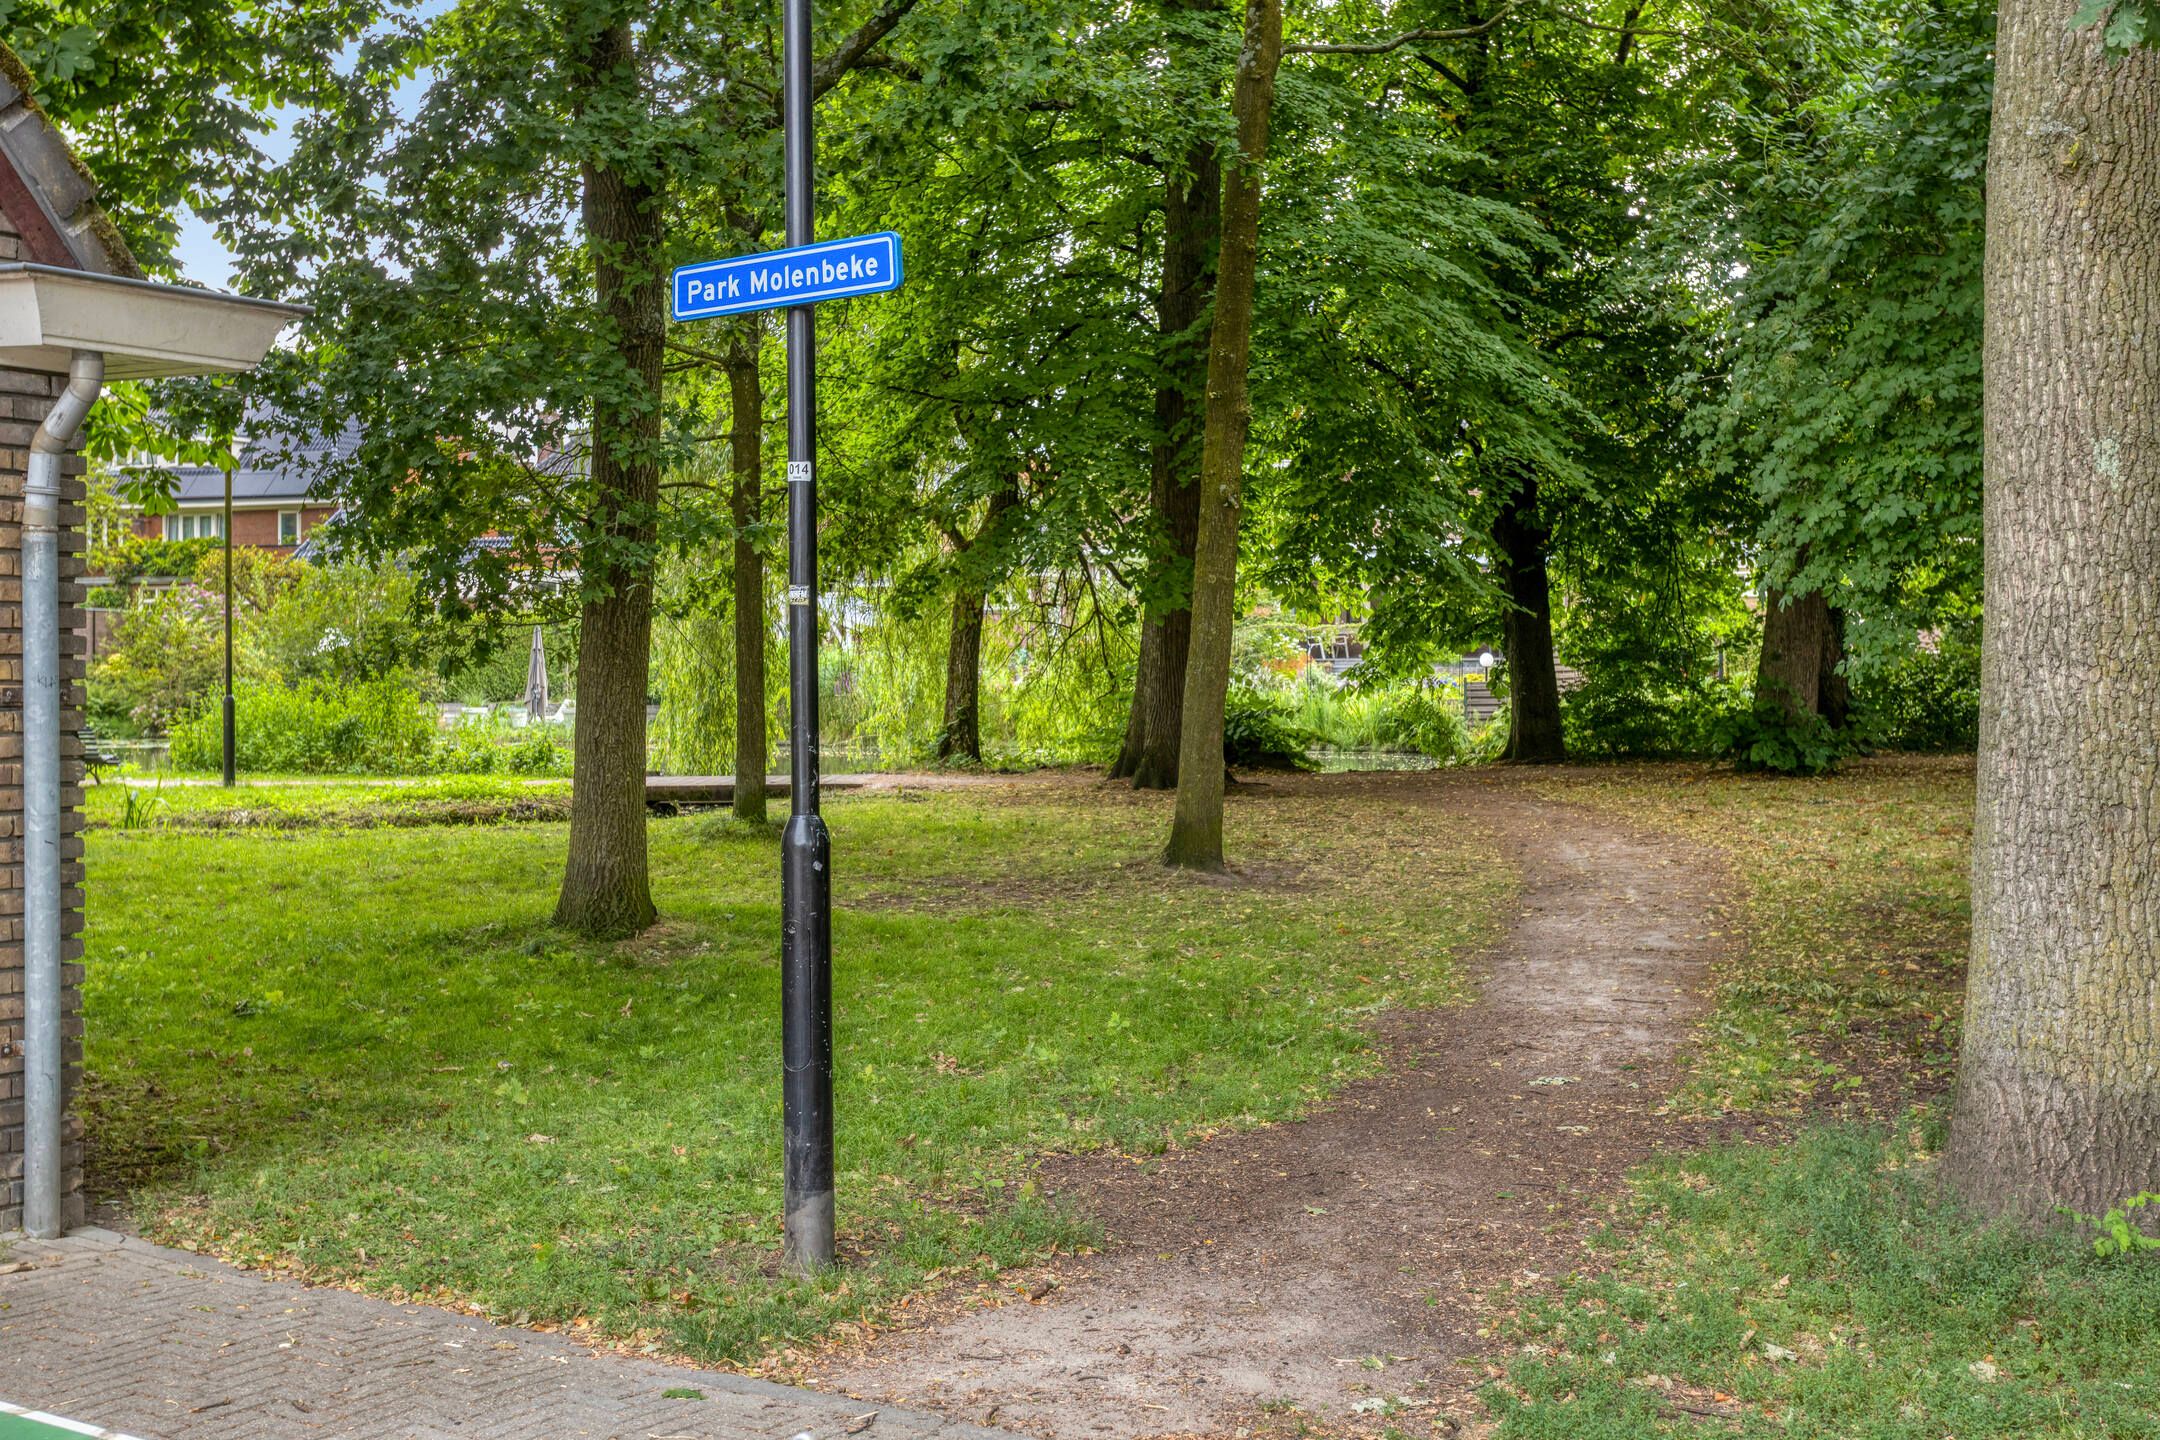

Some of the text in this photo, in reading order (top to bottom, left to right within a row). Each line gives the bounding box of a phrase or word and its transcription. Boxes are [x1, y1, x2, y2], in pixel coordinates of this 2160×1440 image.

[687, 254, 879, 305] Park Molenbeke
[789, 463, 809, 475] 014
